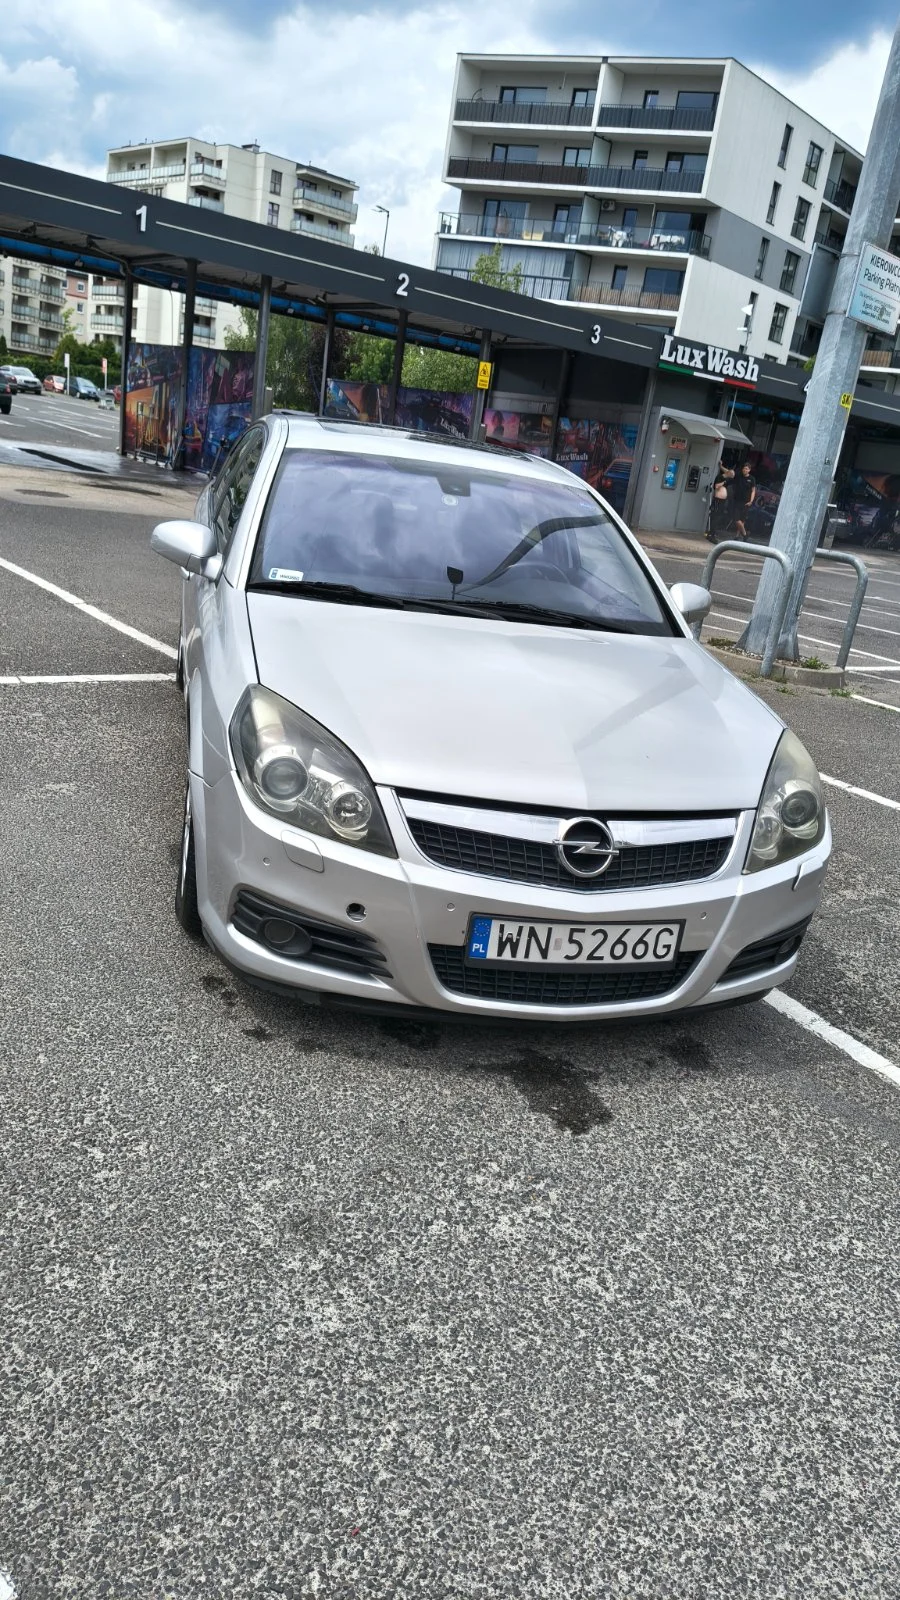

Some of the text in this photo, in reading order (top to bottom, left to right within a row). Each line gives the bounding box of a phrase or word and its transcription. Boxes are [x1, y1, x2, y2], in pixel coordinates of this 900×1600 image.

[135, 204, 147, 232] 1
[396, 272, 410, 297] 2
[864, 268, 885, 290] Parking
[591, 324, 601, 344] 3
[472, 943, 485, 953] PL
[497, 923, 675, 961] WN 5266G
